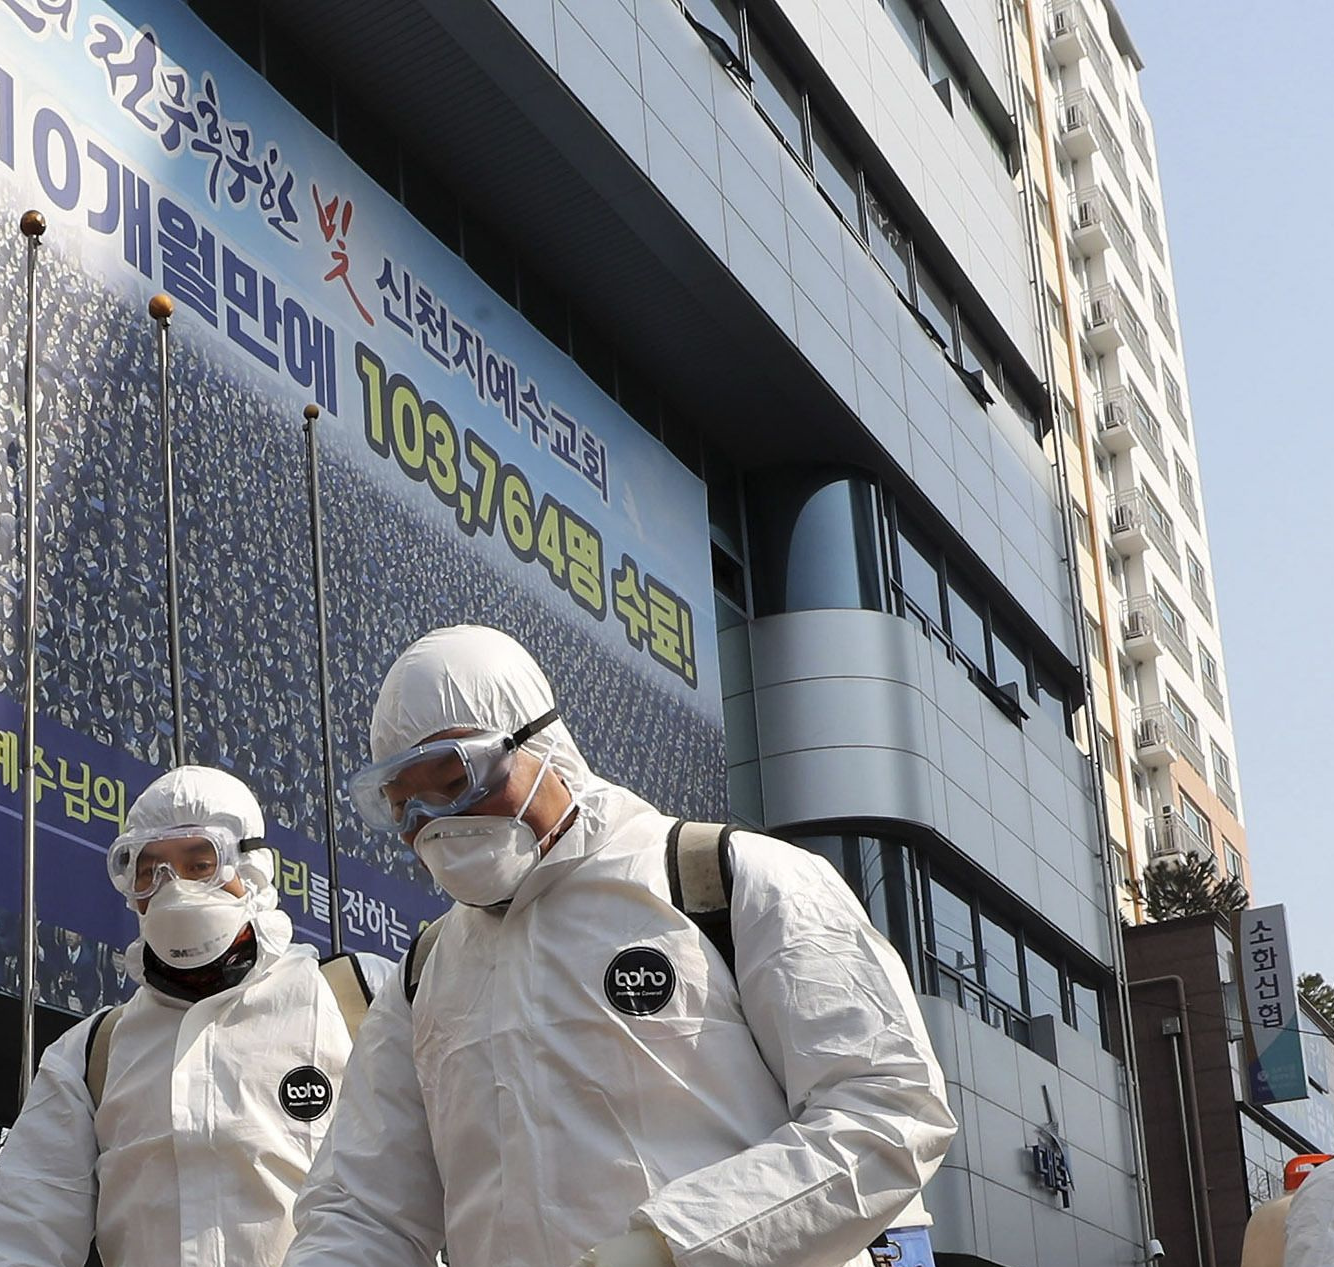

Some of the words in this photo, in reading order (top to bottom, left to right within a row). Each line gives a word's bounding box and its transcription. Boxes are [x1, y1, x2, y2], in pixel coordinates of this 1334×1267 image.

[375, 257, 609, 503] 신천지예수교회
[357, 346, 605, 618] 103,764명
[613, 556, 696, 686] 수료!
[341, 887, 412, 954] 전하는
[1249, 920, 1284, 1029] 소화신협
